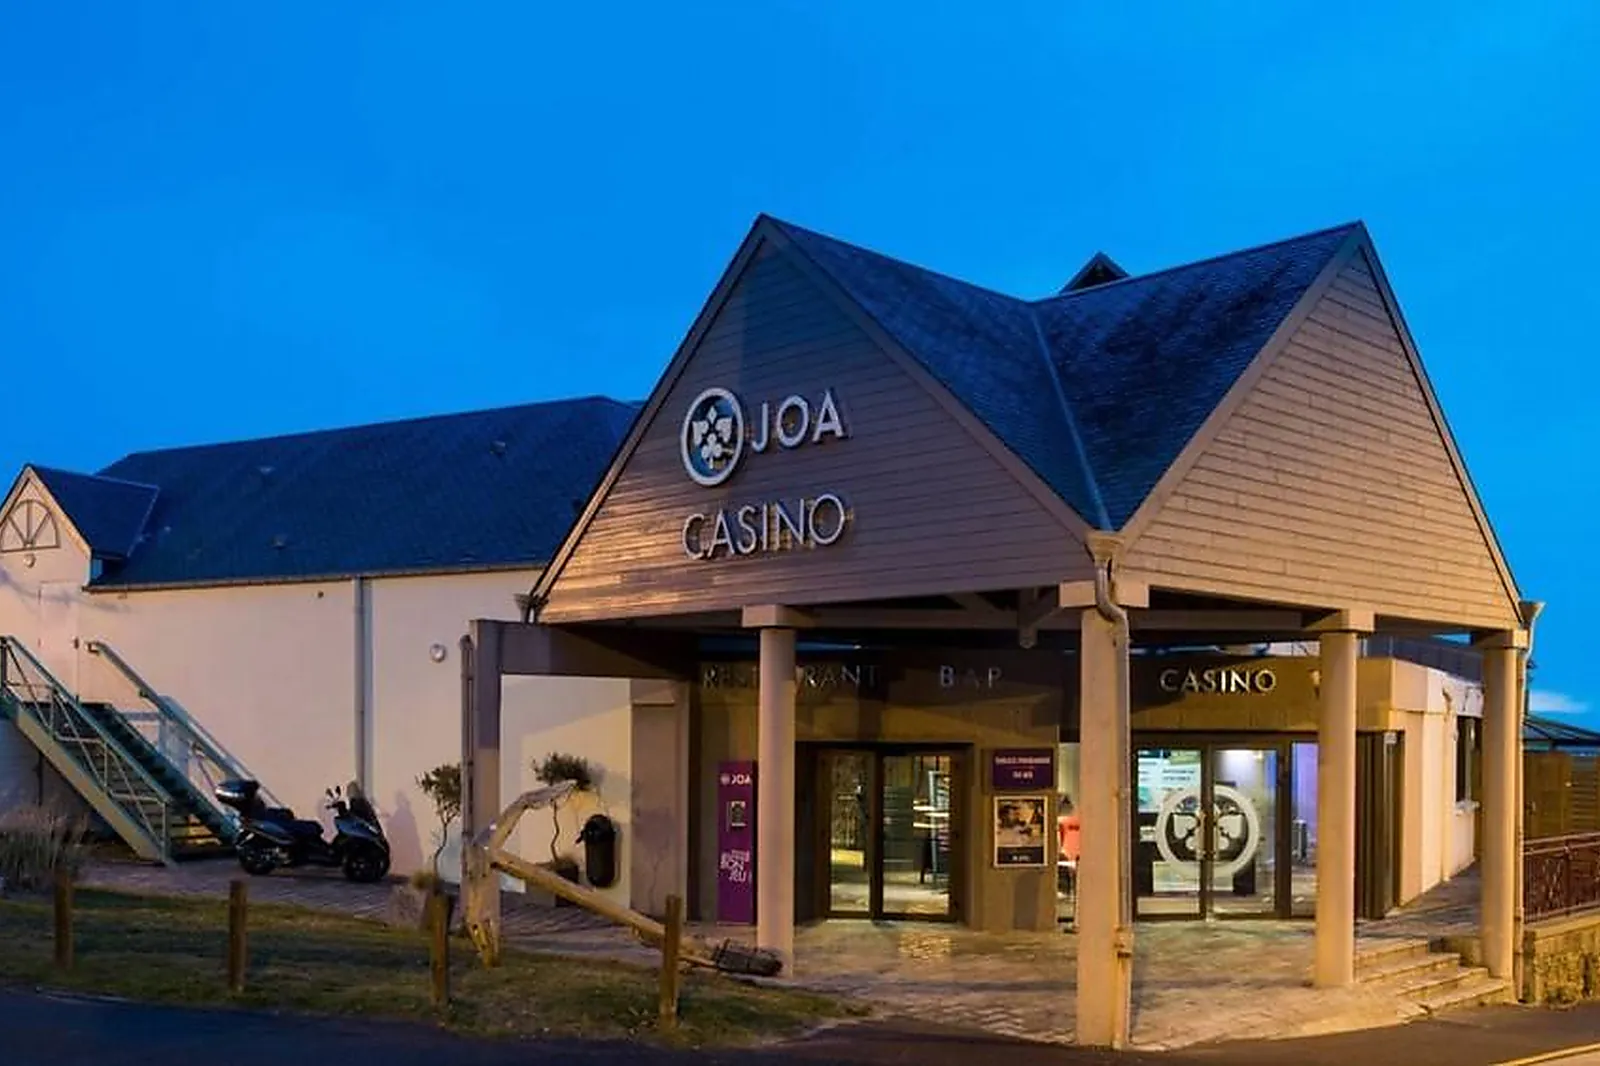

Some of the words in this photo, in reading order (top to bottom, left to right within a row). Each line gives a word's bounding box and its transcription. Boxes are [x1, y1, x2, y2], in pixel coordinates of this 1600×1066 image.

[751, 388, 844, 453] JOA
[682, 493, 845, 560] CASINO
[1159, 666, 1277, 693] CASINO
